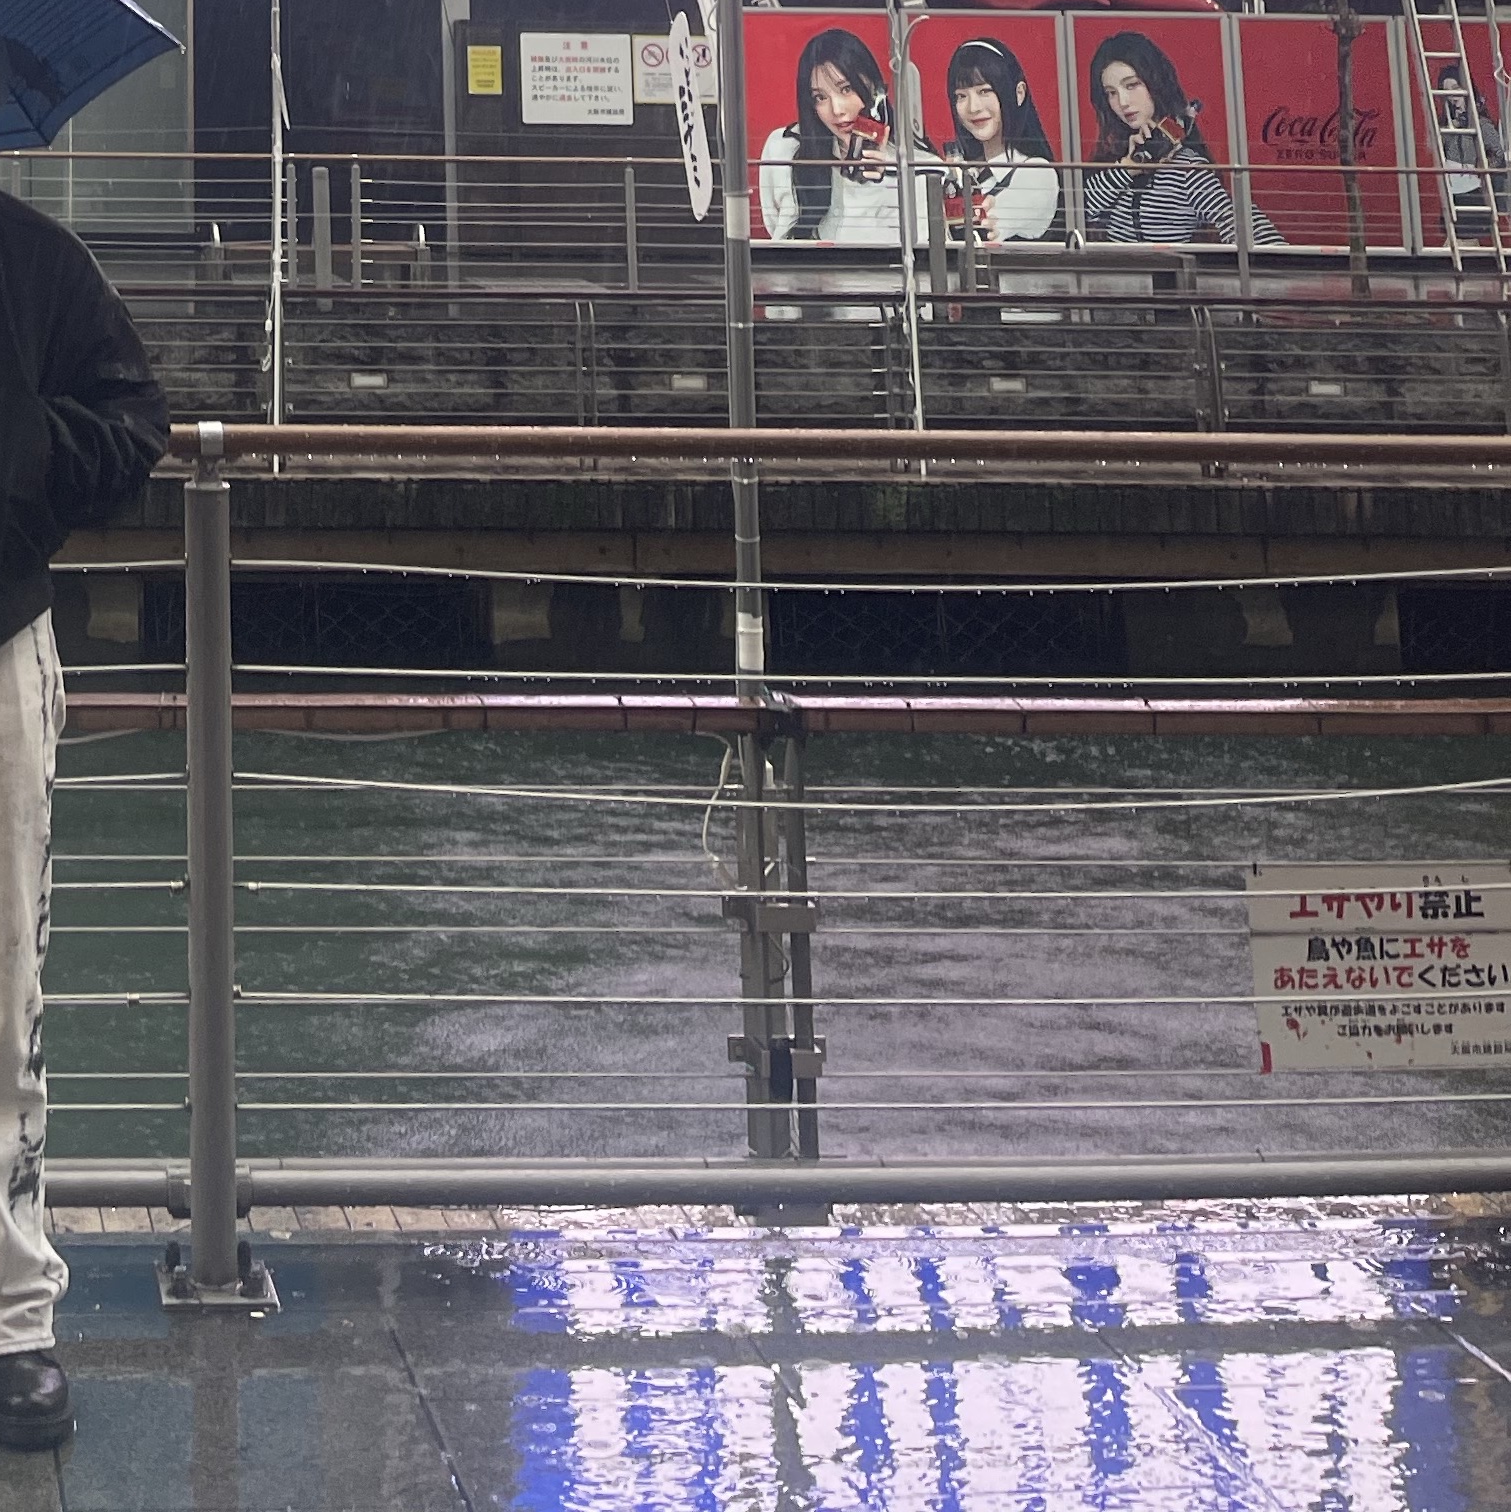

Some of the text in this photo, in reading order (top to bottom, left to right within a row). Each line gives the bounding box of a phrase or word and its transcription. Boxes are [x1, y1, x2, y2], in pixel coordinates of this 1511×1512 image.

[1290, 890, 1485, 919] エサやり禁止
[1307, 935, 1471, 962] 鳥や魚にエサを
[1273, 962, 1509, 990] あたえないでください
